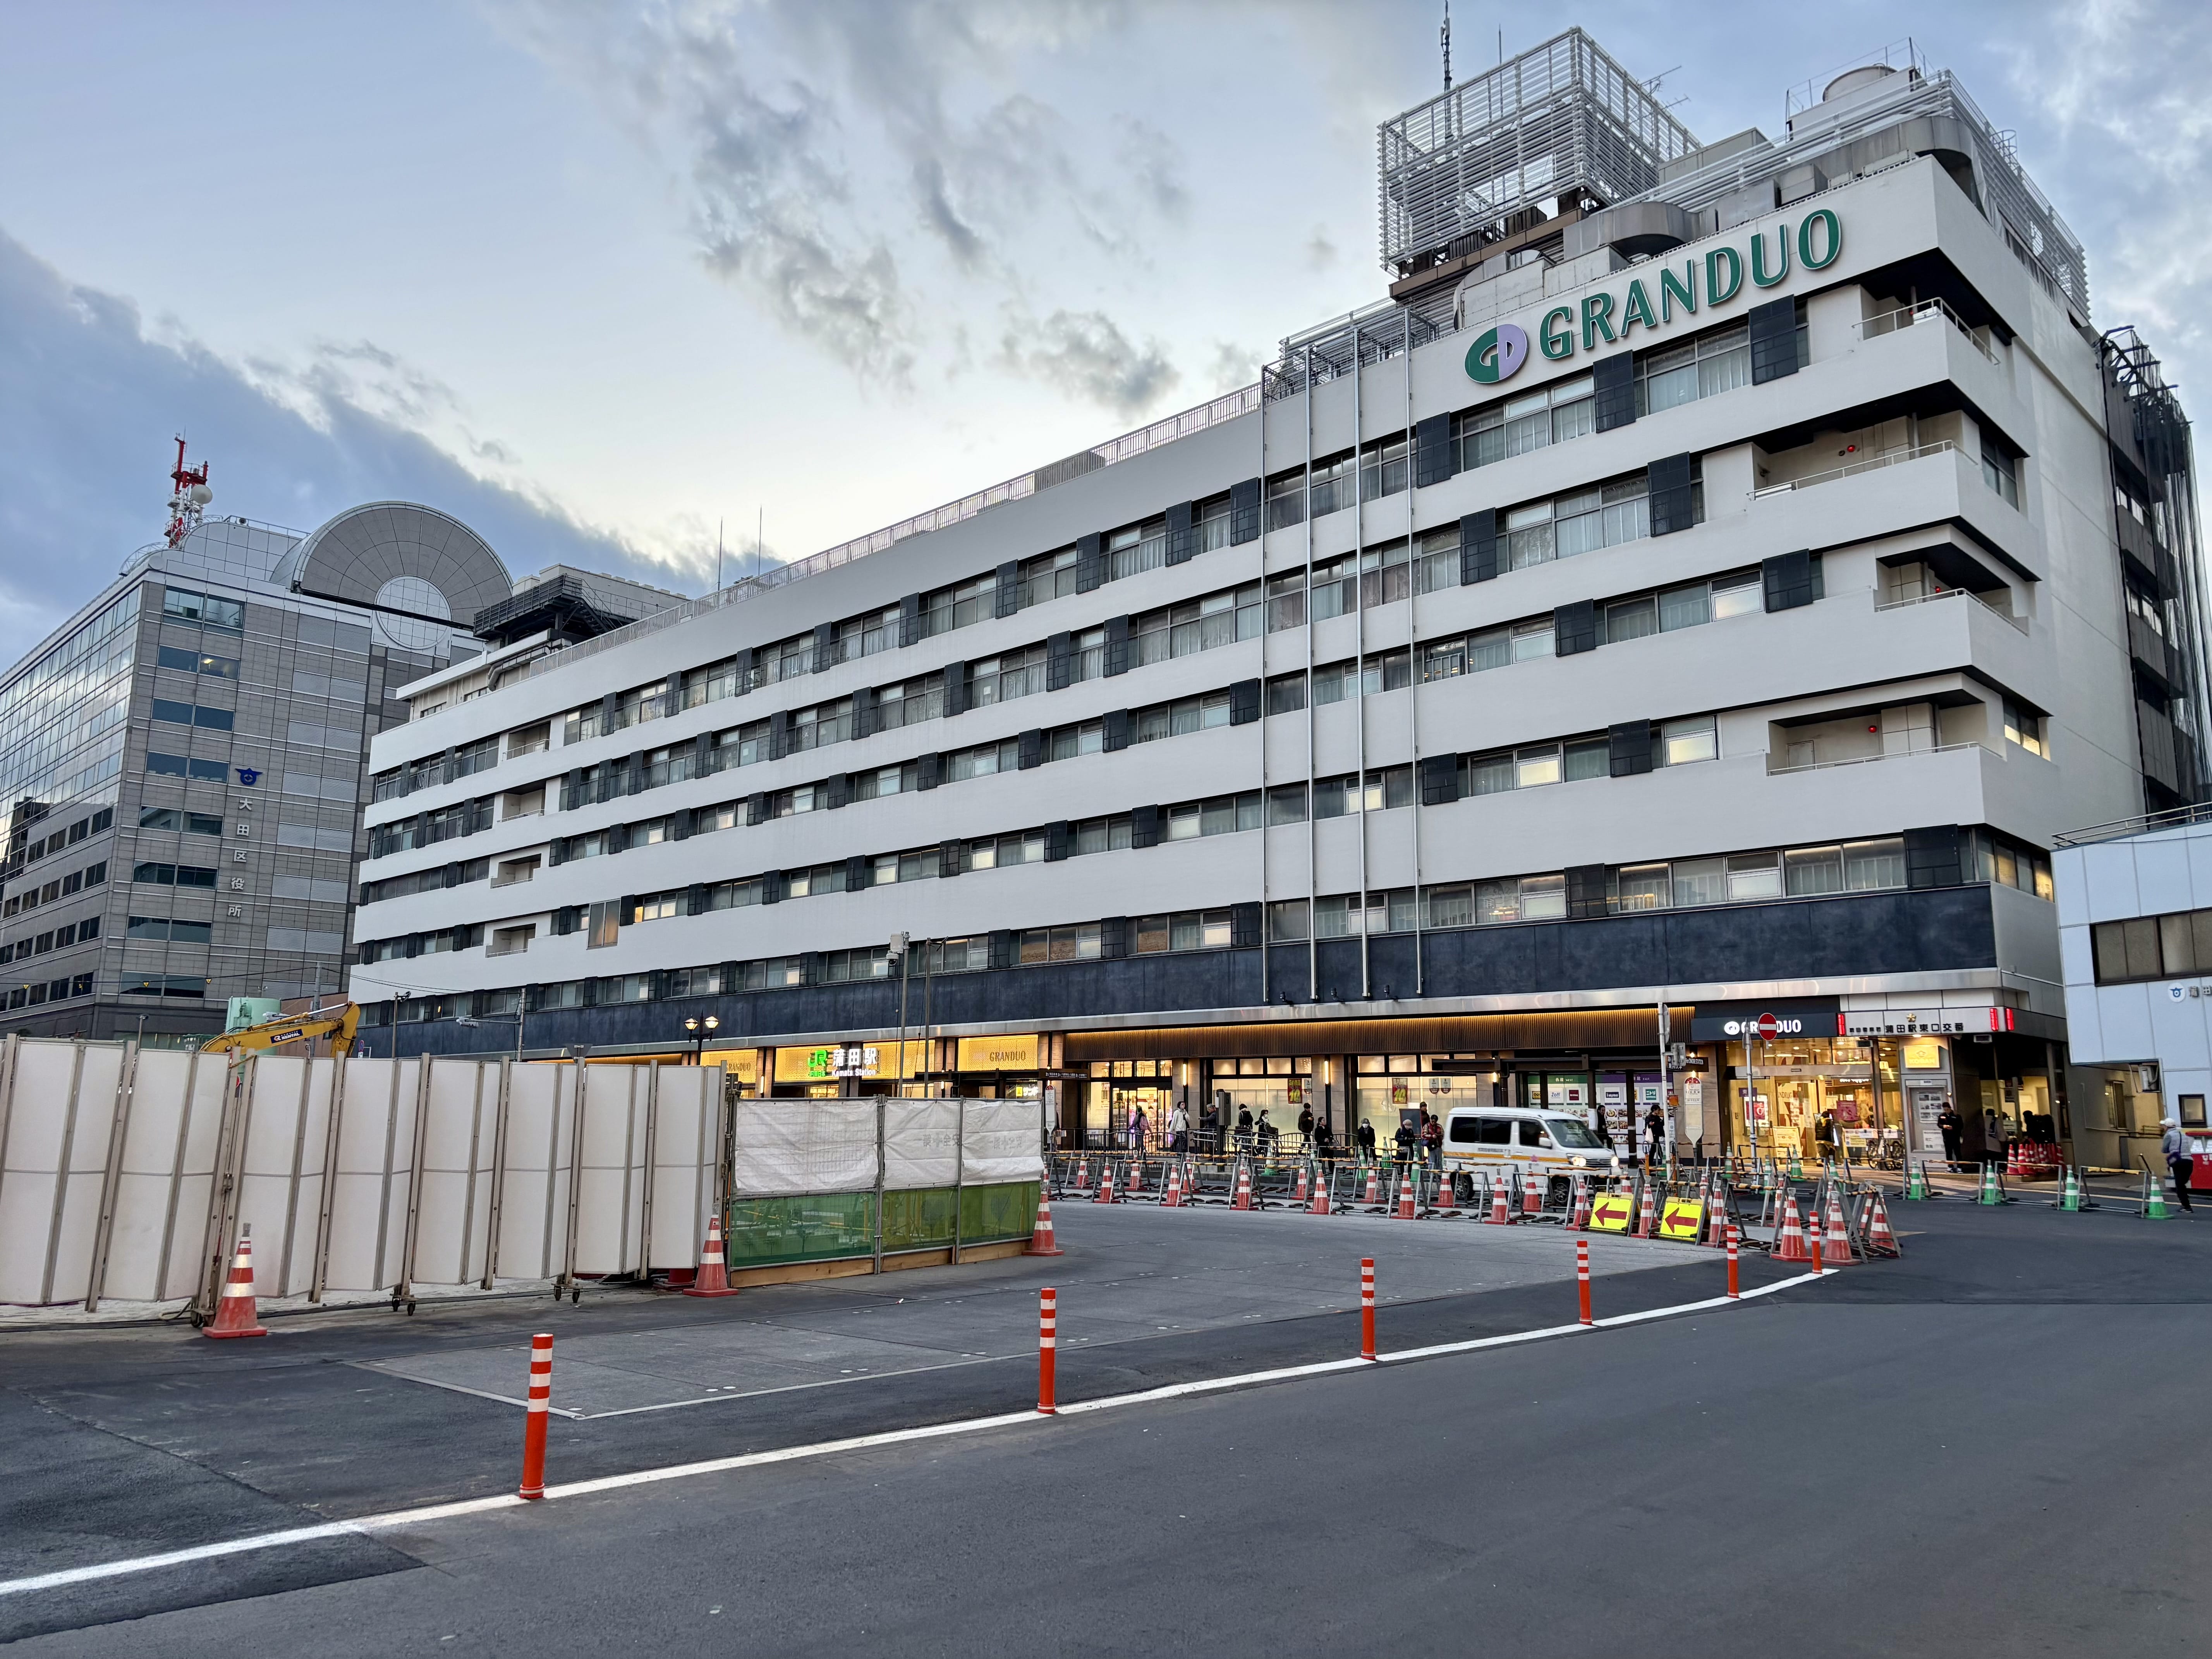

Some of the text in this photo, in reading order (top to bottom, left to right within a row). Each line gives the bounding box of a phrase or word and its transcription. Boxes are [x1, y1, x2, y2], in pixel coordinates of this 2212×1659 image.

[1539, 209, 1843, 359] GRANDUO
[228, 798, 253, 917] 大田区役所
[1885, 1023, 1964, 1033] 蒲田駅東口交番
[807, 1050, 827, 1067] JR
[833, 1048, 878, 1066] 蒲田駅
[989, 1051, 1027, 1061] GRANDUO
[727, 1063, 750, 1072] RANDUO
